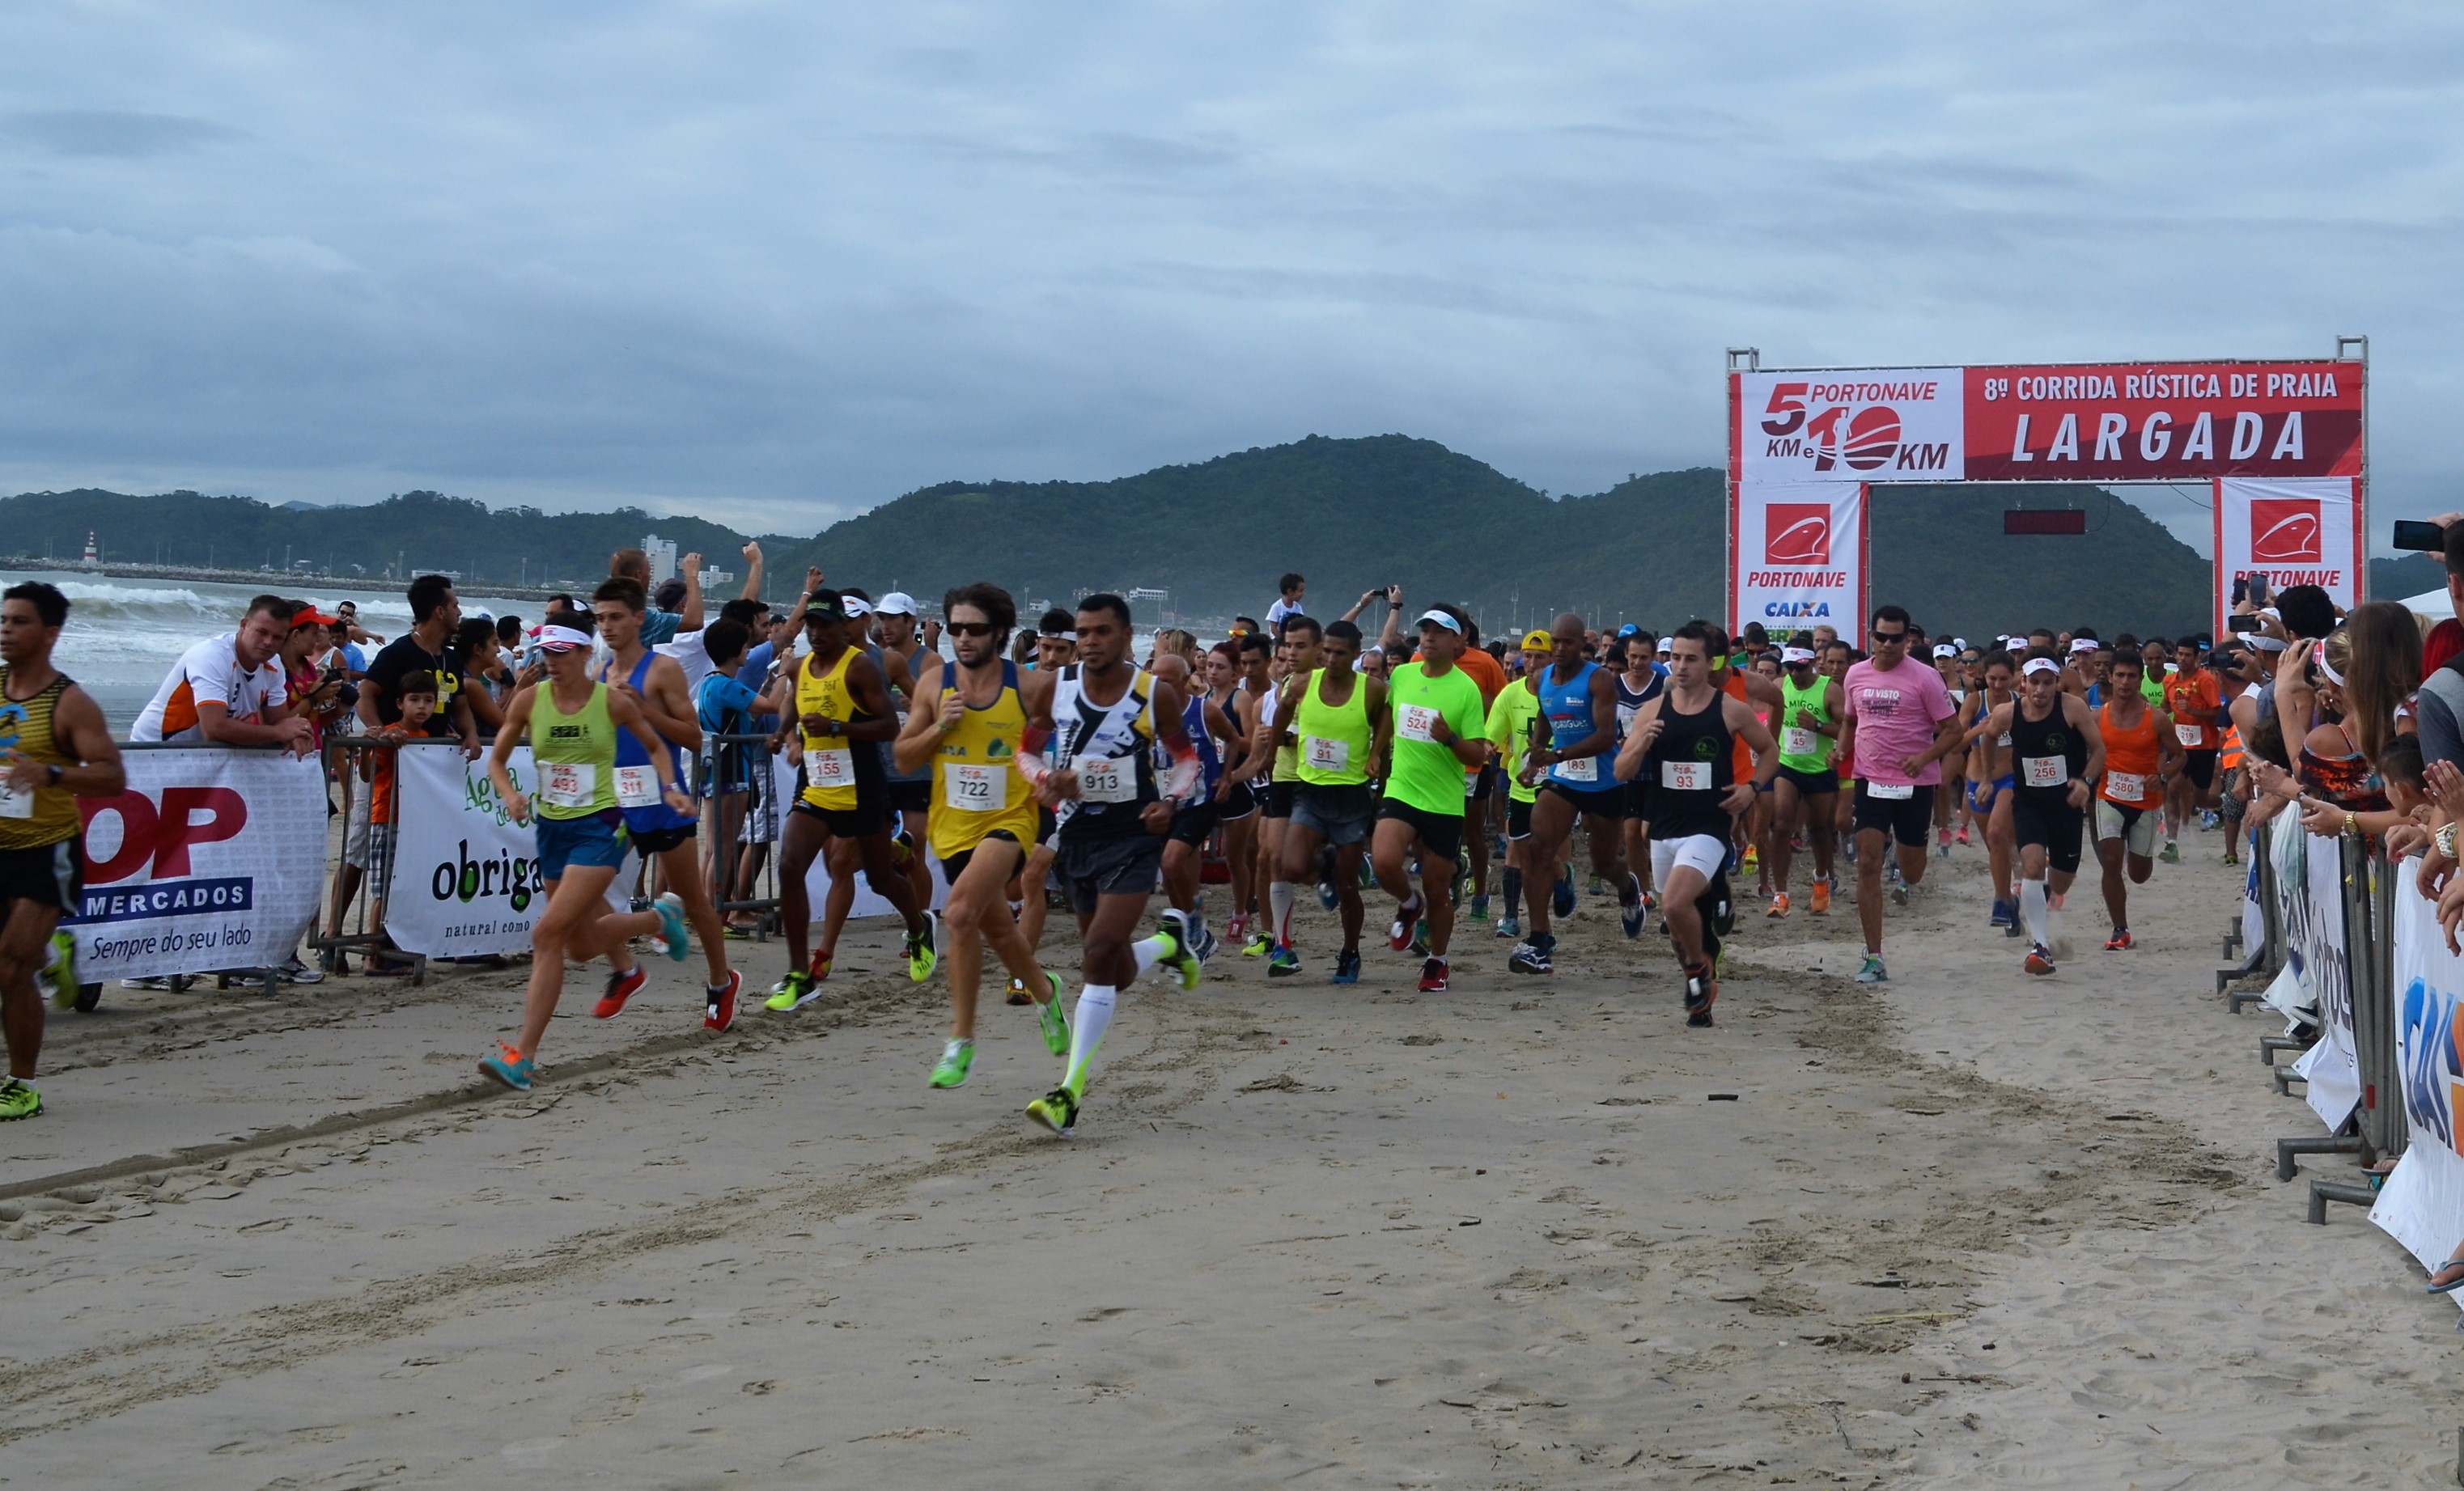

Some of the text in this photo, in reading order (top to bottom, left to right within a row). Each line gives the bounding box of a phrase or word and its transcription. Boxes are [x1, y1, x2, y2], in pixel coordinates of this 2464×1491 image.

[1811, 382, 1938, 403] PORTONAVE
[2017, 375, 2117, 400] CORRIDA
[2126, 369, 2221, 400] RÚSTICA
[2231, 374, 2258, 398] DE
[2267, 373, 2338, 397] PRAIA
[1761, 383, 1809, 437] 5
[1808, 405, 1902, 472] 10
[2012, 411, 2304, 462] LARGADA
[1766, 438, 1815, 459] KM e
[1896, 443, 1949, 470] KM
[1747, 571, 1847, 587] PORTONAVE
[1765, 602, 1830, 617] CAIXA
[1864, 688, 1874, 697] EU
[1407, 717, 1427, 730] 524
[1793, 738, 1805, 746] 45
[1317, 749, 1330, 759] 91
[816, 763, 840, 775] 155
[2034, 767, 2056, 777] 256
[551, 777, 578, 793] 493
[621, 781, 643, 794] 311
[959, 781, 988, 796] 722
[1085, 775, 1118, 790] 913
[1677, 776, 1693, 787] 93
[2114, 782, 2134, 793] 580
[75, 786, 248, 885] OP
[74, 885, 244, 917] MERCADOS
[444, 920, 497, 938] natural
[502, 920, 530, 934] como
[90, 923, 252, 962] Sempre do seu lado
